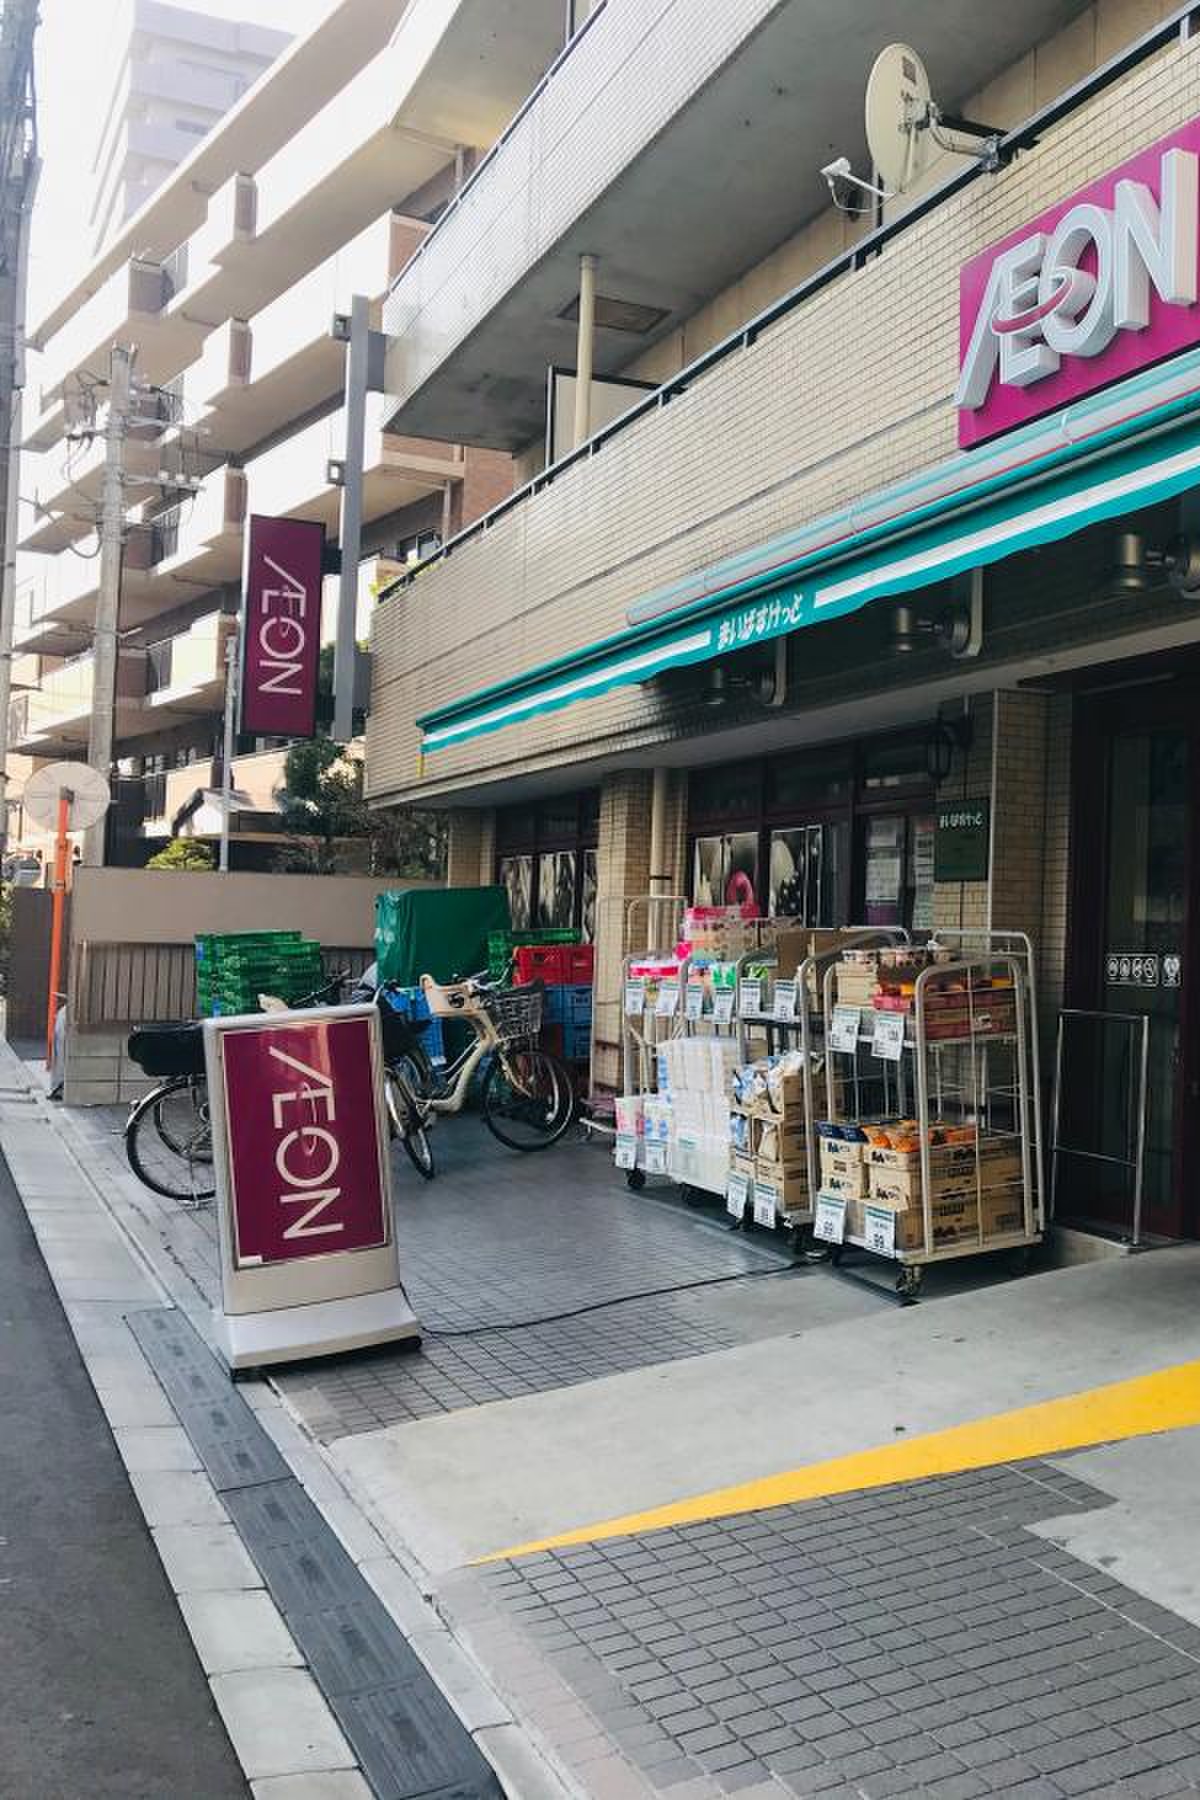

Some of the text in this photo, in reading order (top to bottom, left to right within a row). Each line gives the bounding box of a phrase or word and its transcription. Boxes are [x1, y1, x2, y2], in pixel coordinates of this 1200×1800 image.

[258, 554, 307, 695] AEON
[717, 592, 804, 651] まいばすけっと
[268, 1046, 345, 1239] AEON
